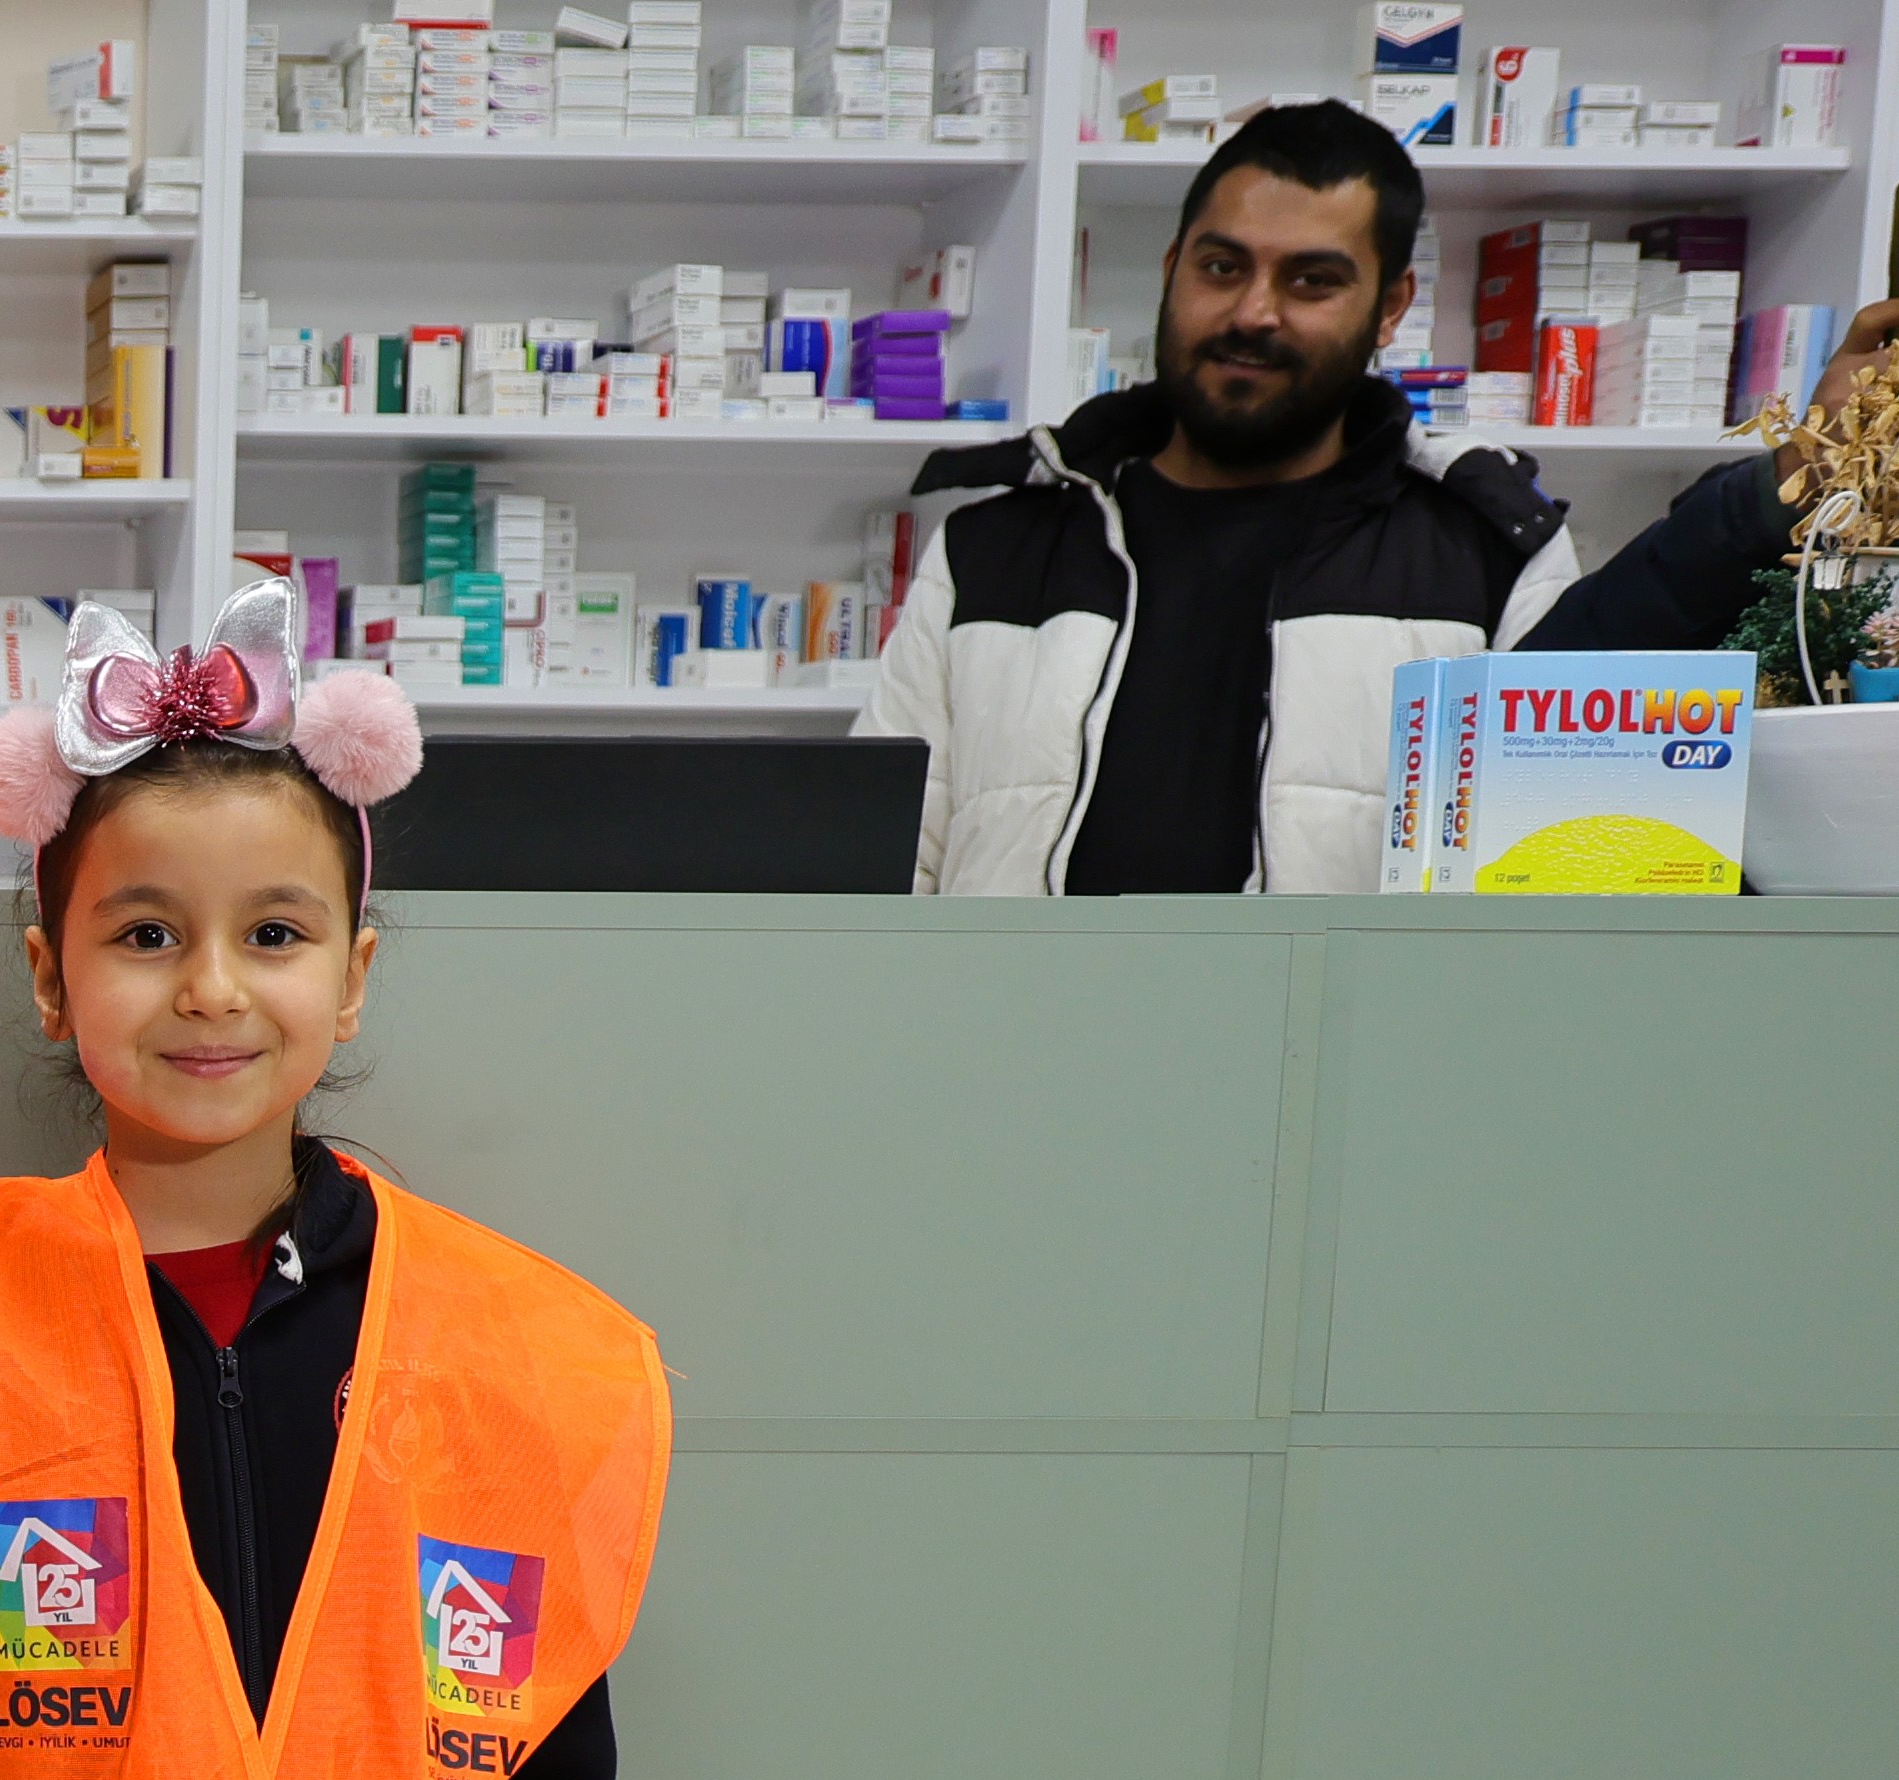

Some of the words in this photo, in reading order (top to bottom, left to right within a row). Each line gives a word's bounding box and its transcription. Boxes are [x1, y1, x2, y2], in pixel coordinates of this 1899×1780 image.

[1672, 745, 1724, 766] DAY
[38, 1564, 81, 1608] 25
[54, 1612, 72, 1623] YIL
[450, 1609, 490, 1656] 25
[460, 1658, 478, 1670] YIL
[93, 1736, 131, 1748] UMUT
